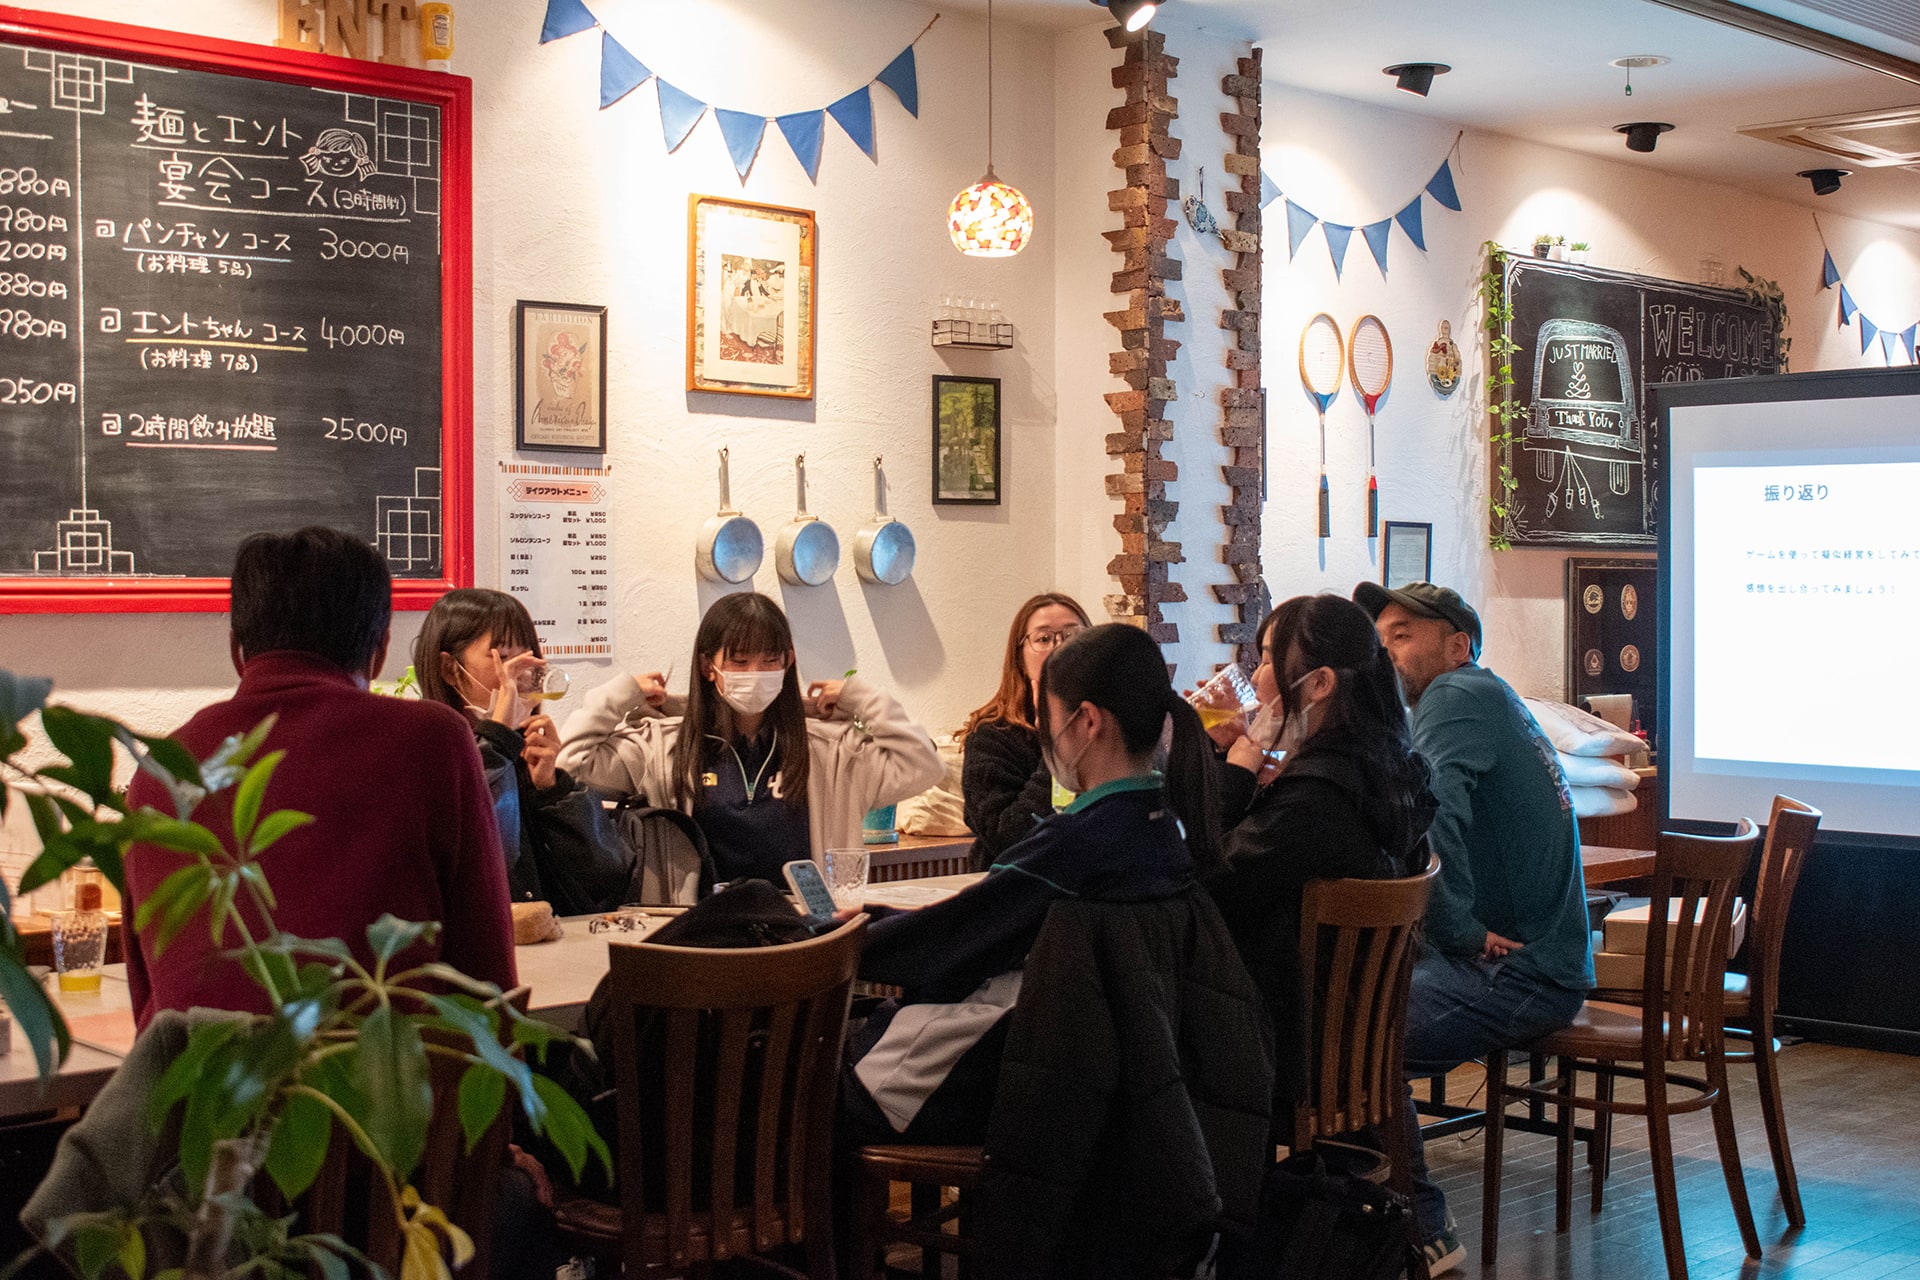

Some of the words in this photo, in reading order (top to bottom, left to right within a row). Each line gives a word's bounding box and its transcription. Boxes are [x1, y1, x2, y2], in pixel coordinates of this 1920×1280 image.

[131, 92, 303, 148] 麺とエント
[242, 232, 291, 251] コース
[319, 228, 410, 264] 3000円
[132, 311, 252, 339] エントちゃん
[263, 323, 306, 342] コース
[321, 317, 405, 349] 4000円
[1648, 304, 1775, 369] WELCOME
[221, 353, 258, 373] 7品)
[1549, 344, 1580, 363] JUST
[1580, 344, 1618, 363] MARRIED
[128, 412, 277, 440] 2時間飲み放題
[322, 416, 408, 447] 2500円
[525, 486, 589, 497] テイクアウトメニュー
[1764, 484, 1829, 501] 振り返り
